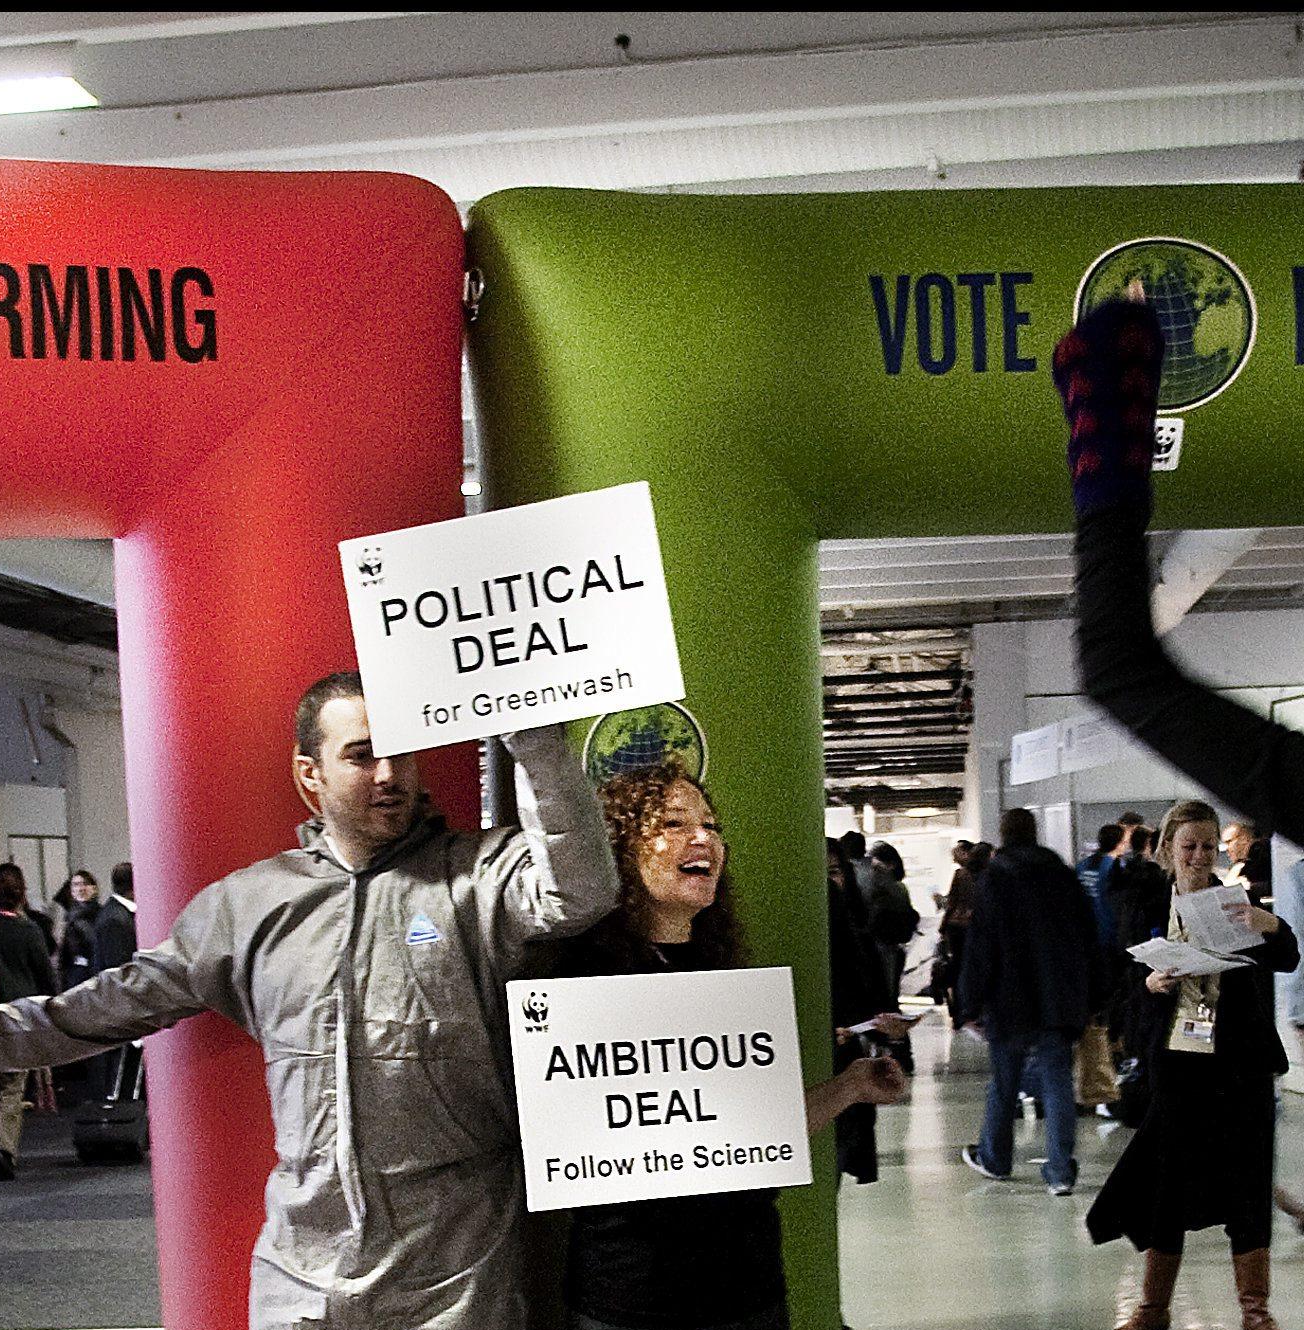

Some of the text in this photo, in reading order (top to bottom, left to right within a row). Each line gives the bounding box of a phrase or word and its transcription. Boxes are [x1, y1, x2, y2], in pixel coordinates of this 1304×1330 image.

[868, 271, 1037, 376] VOTE
[380, 554, 644, 636] POLITICAL
[452, 617, 588, 674] DEAL
[421, 668, 634, 727] for Greenwash
[544, 1031, 776, 1082] AMBITIOUS
[605, 1088, 718, 1129] DEAL
[546, 1143, 794, 1182] Follow the Science
